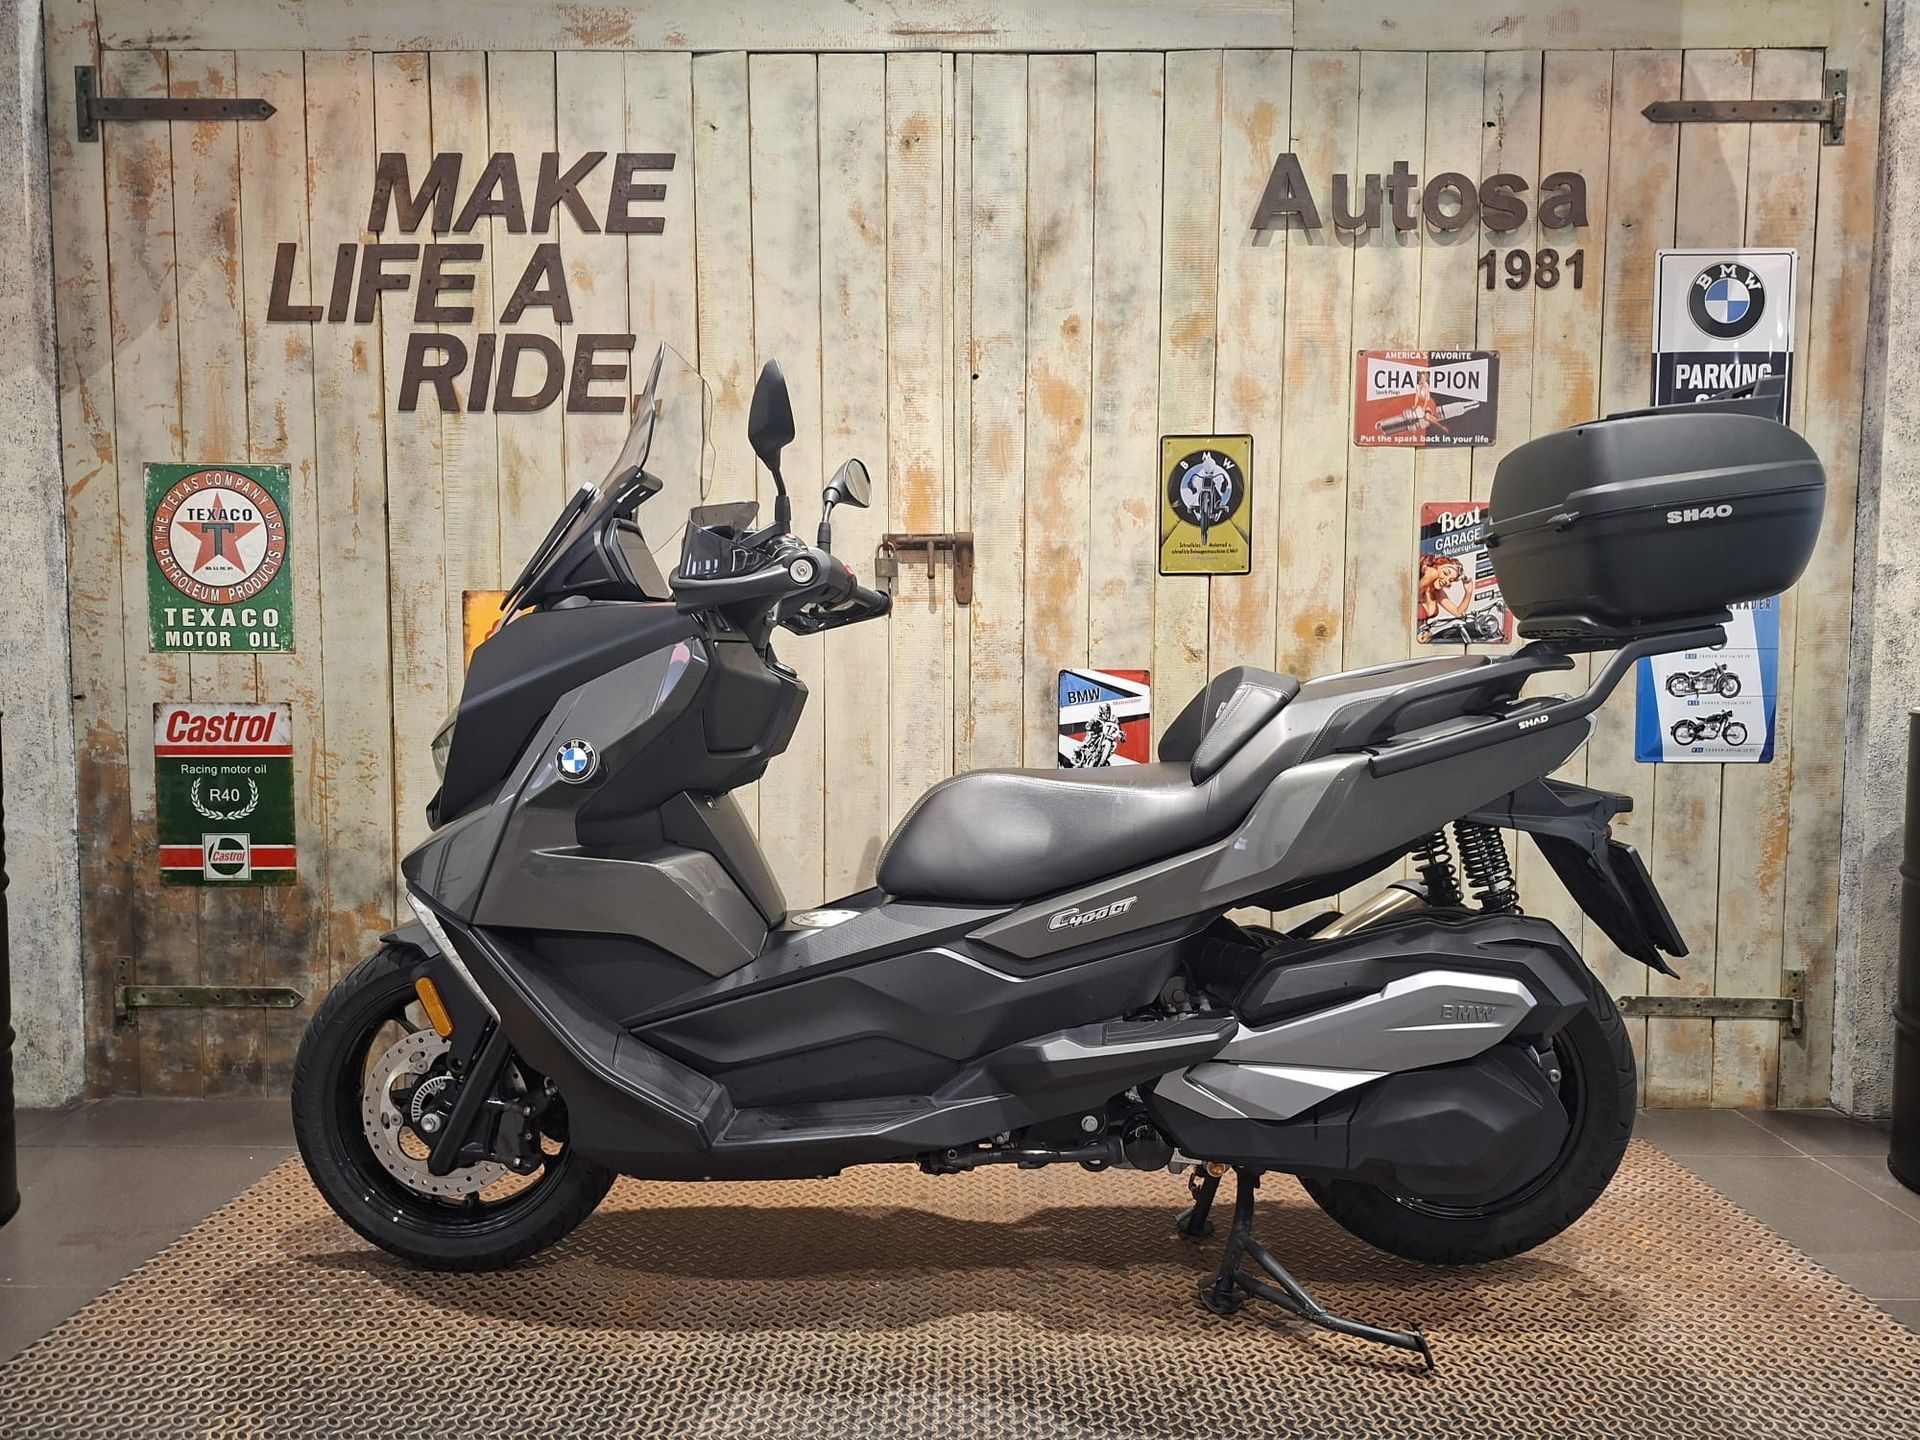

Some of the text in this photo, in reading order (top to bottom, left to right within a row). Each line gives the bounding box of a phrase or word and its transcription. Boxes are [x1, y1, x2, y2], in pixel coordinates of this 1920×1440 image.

[367, 152, 677, 233] MAKE
[1250, 152, 1590, 231] Autosa
[1478, 249, 1585, 290] 1981
[1696, 264, 1761, 291] BMW
[267, 242, 574, 323] LIFE A
[1385, 351, 1472, 360] AMERICA'S FAVORITE
[397, 332, 637, 413] RIDE
[1360, 434, 1375, 442] Put
[1394, 435, 1419, 444] spark
[1420, 434, 1440, 442] back
[1452, 436, 1472, 444] your
[1475, 434, 1489, 443] life
[1180, 451, 1235, 470] BMW
[154, 515, 169, 542] THE
[162, 476, 200, 512] TEXAS
[205, 472, 269, 506] COMPANY
[187, 508, 253, 522] TEXACO
[1666, 504, 1733, 524] SH40
[1437, 505, 1481, 533] Best
[1435, 527, 1481, 551] GARAGE
[156, 547, 282, 602] PETROLEUM PRODUCTS
[164, 608, 280, 628] TEXACO
[165, 631, 280, 648] MOTOR OIL
[1067, 688, 1101, 704] BMW
[165, 710, 277, 743] Castrol
[1518, 715, 1549, 729] SHAD
[180, 764, 267, 776] Racing motor oil
[209, 788, 240, 802] R40
[212, 850, 246, 862] Castrol
[1440, 1004, 1497, 1022] BMW
